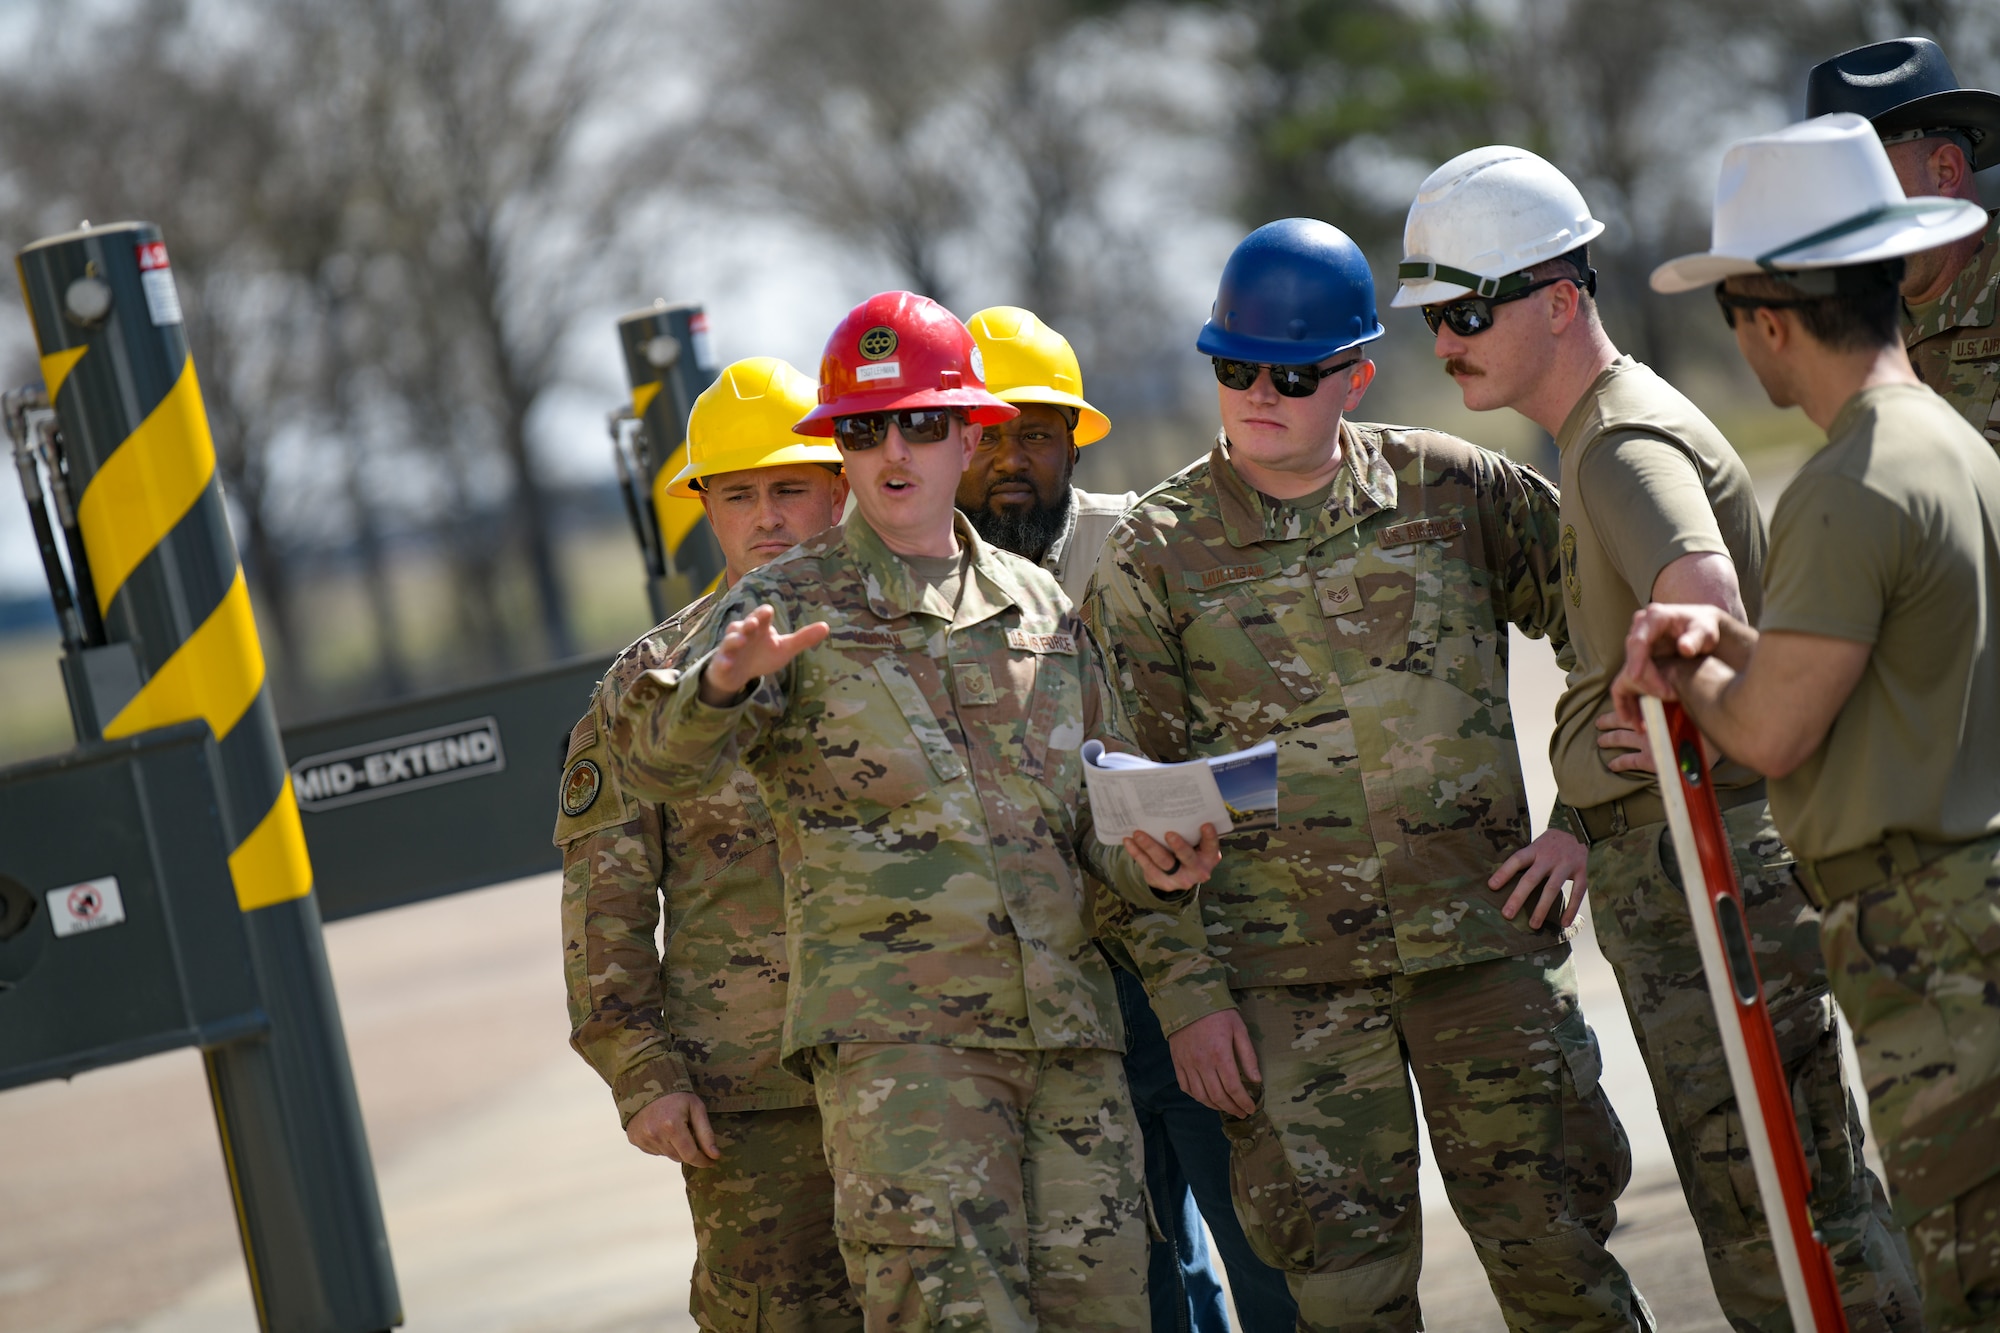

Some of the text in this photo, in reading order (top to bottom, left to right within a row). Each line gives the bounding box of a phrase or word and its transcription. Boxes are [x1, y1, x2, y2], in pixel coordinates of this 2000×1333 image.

[1957, 338, 2000, 357] U.S. AIR
[1201, 564, 1264, 587] MULLIGAN
[1040, 634, 1073, 652] FORCE
[292, 730, 495, 803] MID-EXTEND
